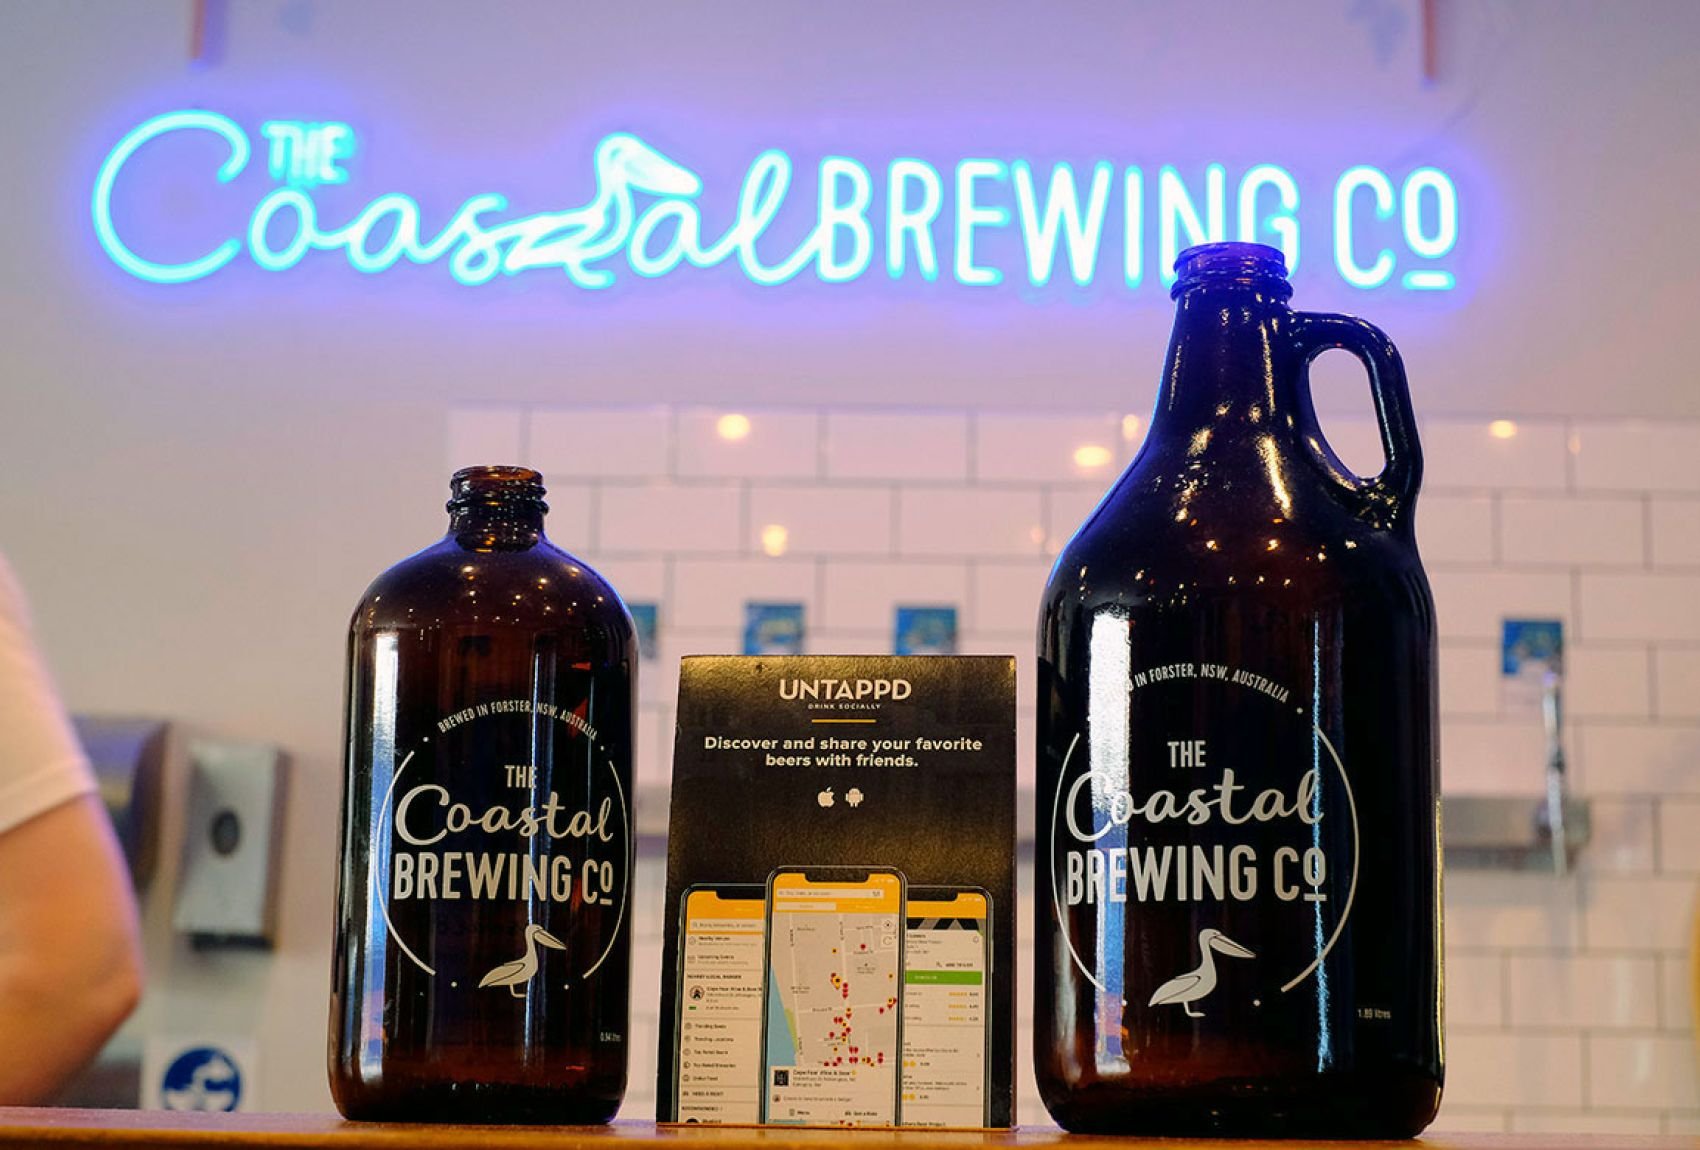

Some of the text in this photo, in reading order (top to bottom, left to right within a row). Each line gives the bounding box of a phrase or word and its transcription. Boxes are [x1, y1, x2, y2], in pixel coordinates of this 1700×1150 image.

[261, 119, 354, 183] THE
[816, 157, 1301, 290] BREWING
[778, 678, 913, 701] UNTAPPD
[1135, 672, 1149, 689] IN
[1231, 668, 1291, 704] AUSTRALIA
[436, 707, 476, 734] BREWED
[476, 703, 489, 717] IN
[807, 702, 882, 710] DRINK SOCIALLY
[704, 736, 983, 754] Discover and share your favorite
[765, 753, 919, 767] beers with friends.
[1167, 740, 1207, 768] THE
[504, 764, 539, 789] THE
[394, 783, 615, 846] Coastal
[1065, 767, 1326, 843] Coastal
[393, 851, 573, 903] BREWING
[1066, 844, 1258, 906] BREWING
